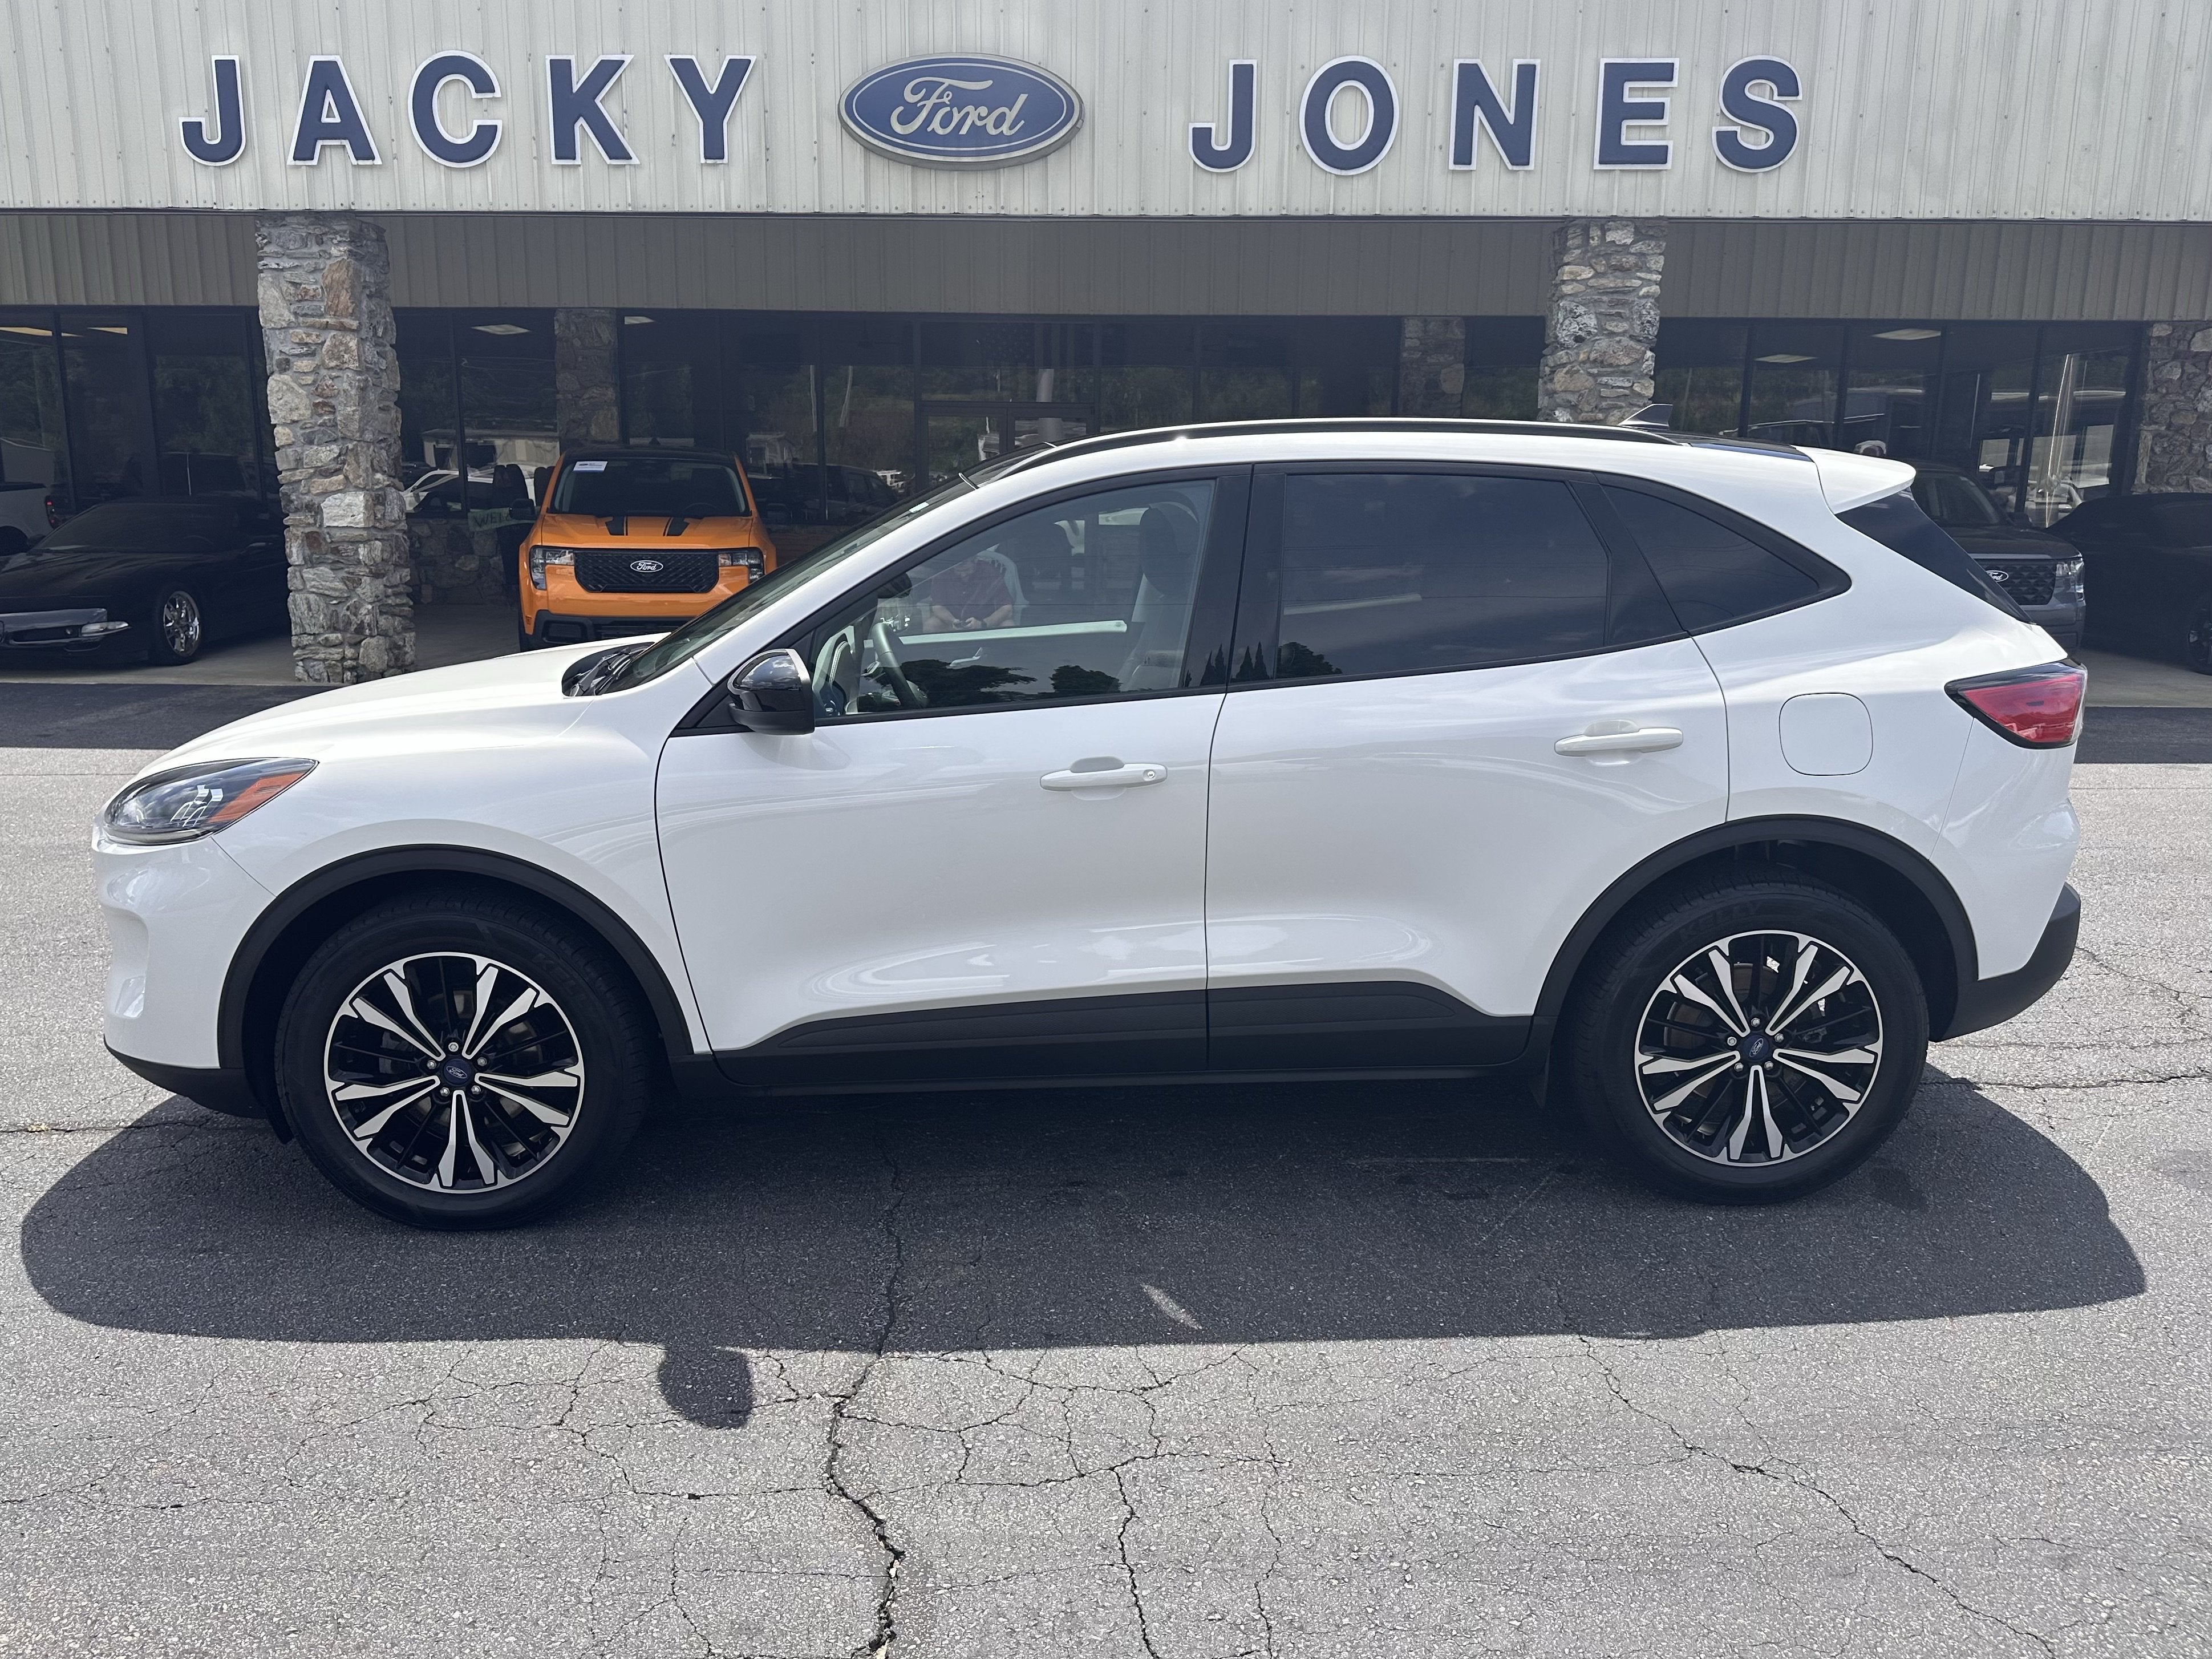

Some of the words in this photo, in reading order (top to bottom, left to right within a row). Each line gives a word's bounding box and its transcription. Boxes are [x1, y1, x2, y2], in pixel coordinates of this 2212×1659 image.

[179, 50, 757, 168] JACKY
[889, 76, 1029, 136] Ford
[1188, 55, 1803, 175] JONES
[636, 561, 658, 570] Ford
